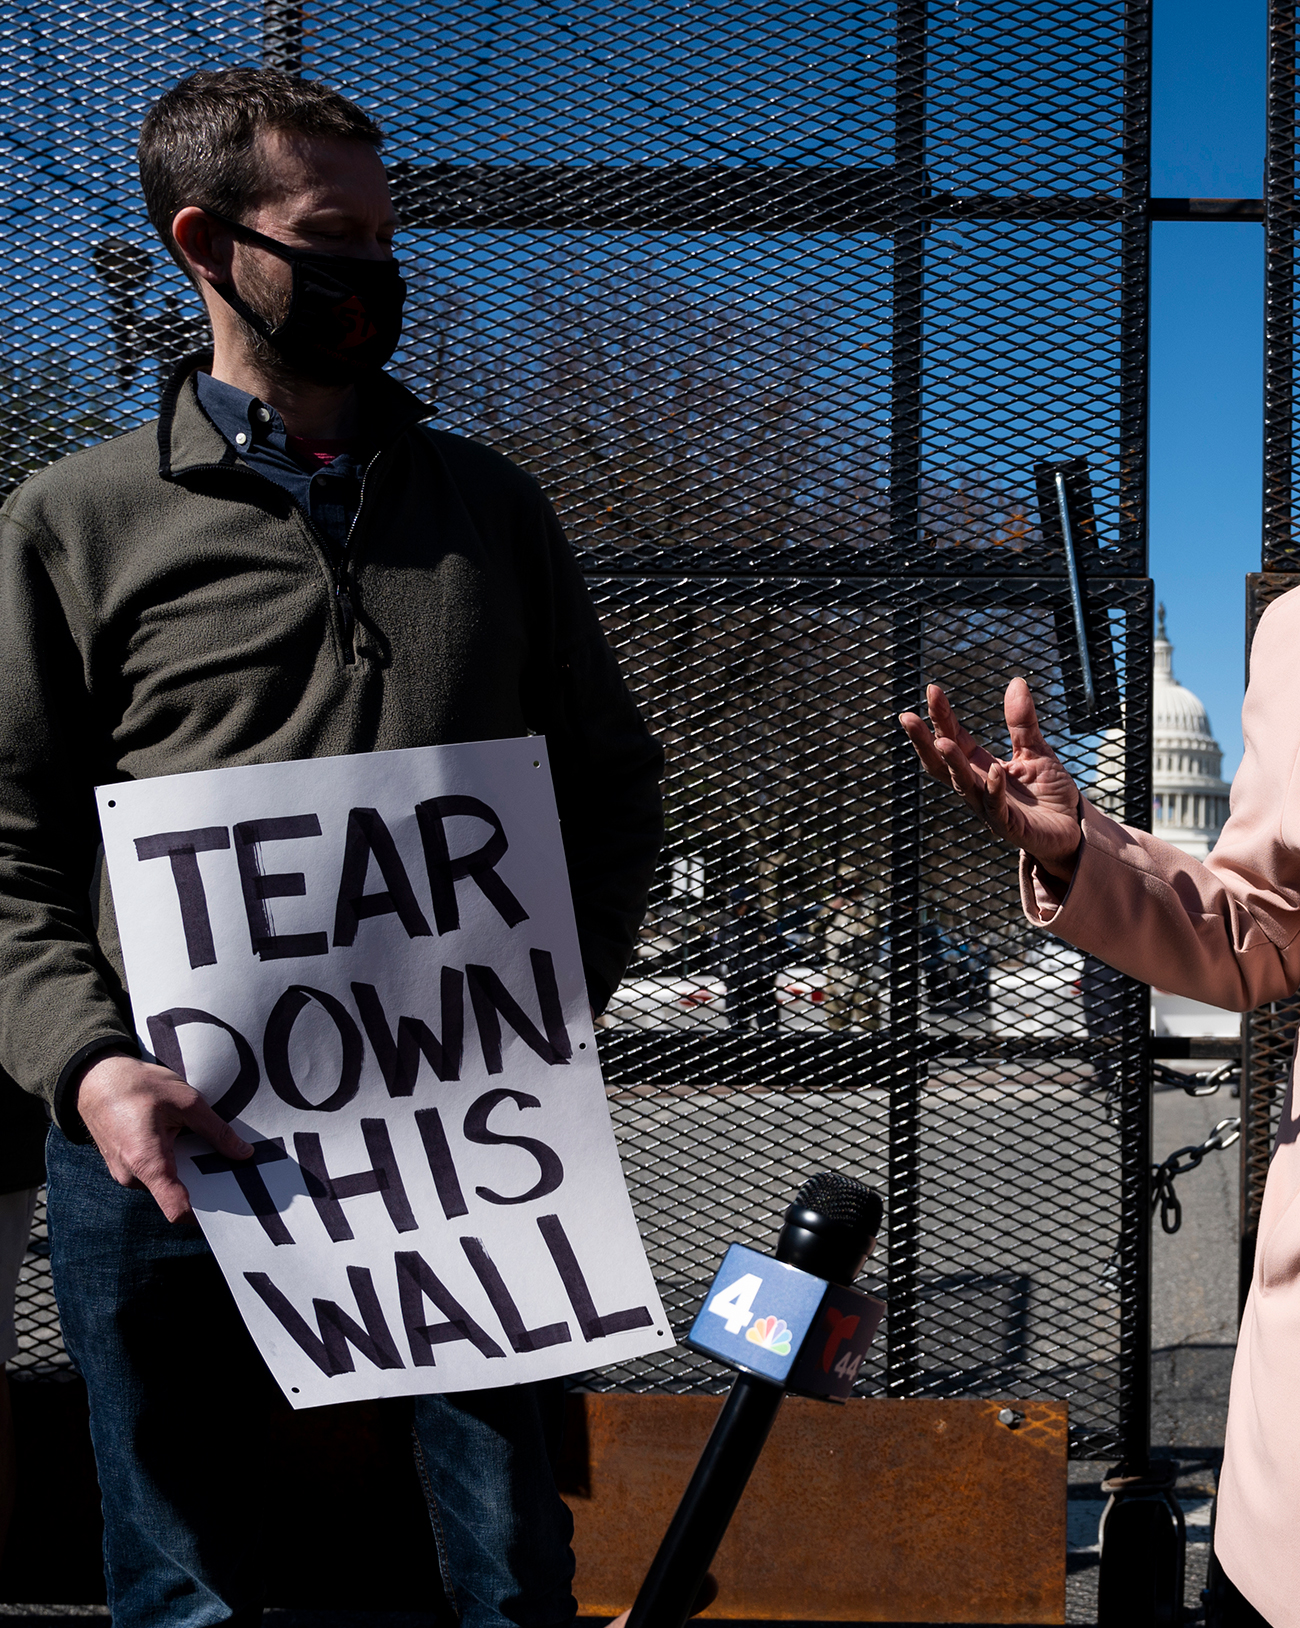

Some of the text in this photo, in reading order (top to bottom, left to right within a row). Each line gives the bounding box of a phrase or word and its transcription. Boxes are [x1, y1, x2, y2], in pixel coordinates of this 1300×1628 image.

[133, 795, 529, 969] TEAR
[146, 948, 573, 1127] DOWN
[190, 1087, 564, 1247] THIS
[243, 1214, 654, 1378] WALL
[708, 1273, 763, 1335] 4
[834, 1351, 862, 1381] 44
